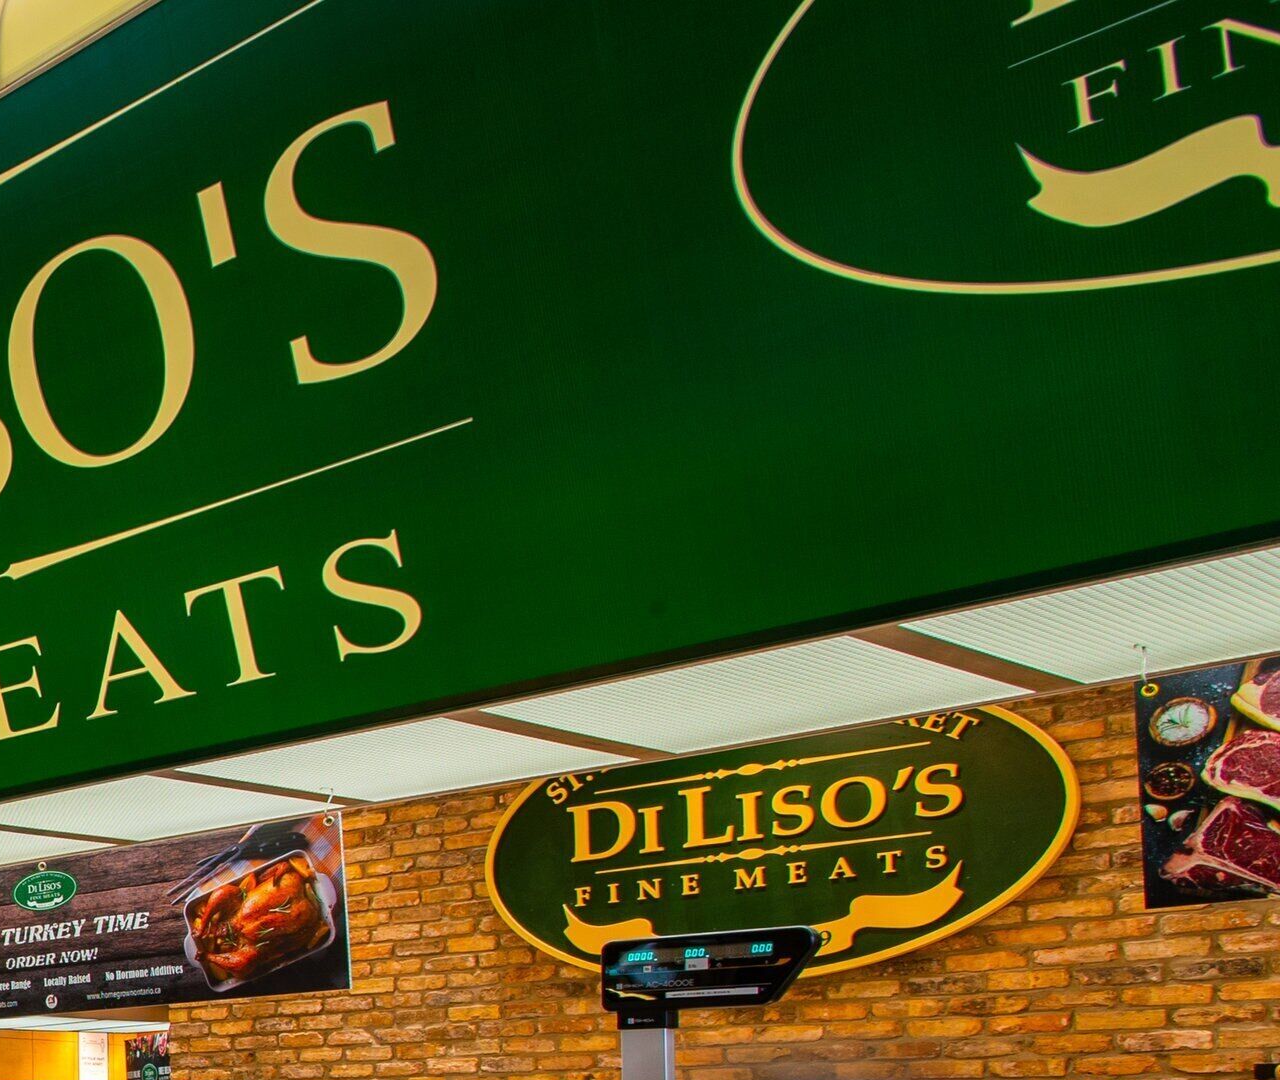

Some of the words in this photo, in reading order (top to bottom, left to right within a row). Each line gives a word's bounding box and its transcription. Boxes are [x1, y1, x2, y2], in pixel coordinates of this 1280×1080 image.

[574, 875, 701, 908] FINE
[734, 845, 948, 889] MEATS
[2, 920, 86, 947] TURKEY
[92, 911, 150, 935] TIME
[5, 952, 56, 970] ORDER
[58, 948, 99, 965] NOW!
[44, 976, 67, 988] Locally
[68, 973, 91, 985] Raised
[105, 971, 115, 981] No
[116, 968, 148, 980] Hormone
[150, 964, 183, 976] Additives
[11, 979, 31, 991] Range
